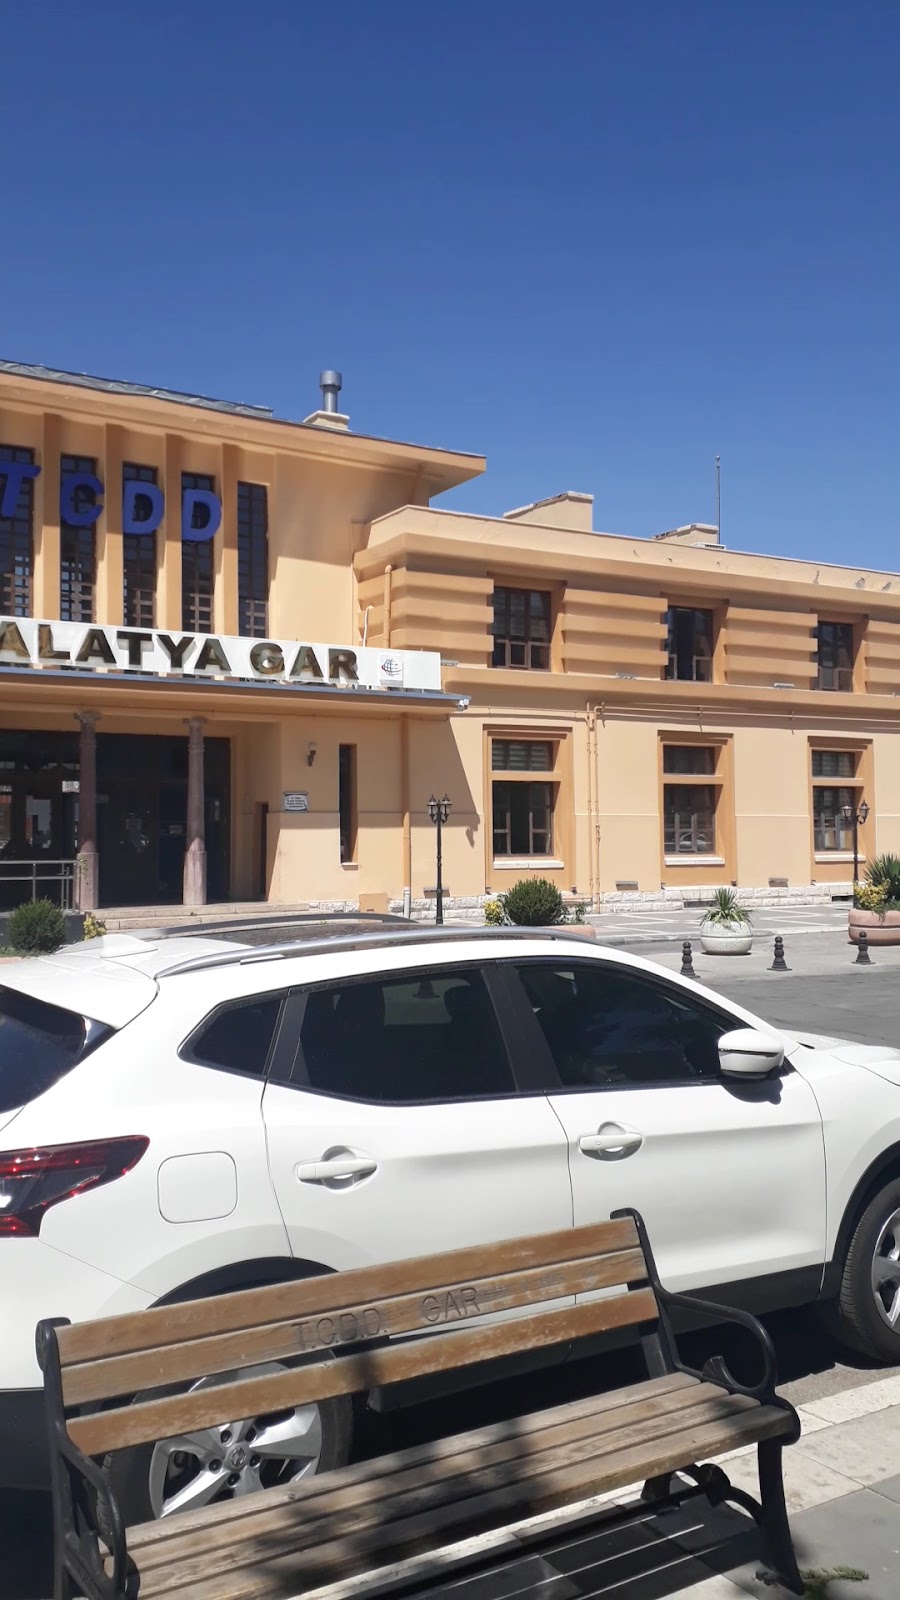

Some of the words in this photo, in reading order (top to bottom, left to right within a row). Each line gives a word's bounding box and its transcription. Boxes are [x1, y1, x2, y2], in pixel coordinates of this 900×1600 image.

[0, 463, 222, 541] TCDD
[250, 642, 360, 680] GAR
[422, 1286, 481, 1322] GAR
